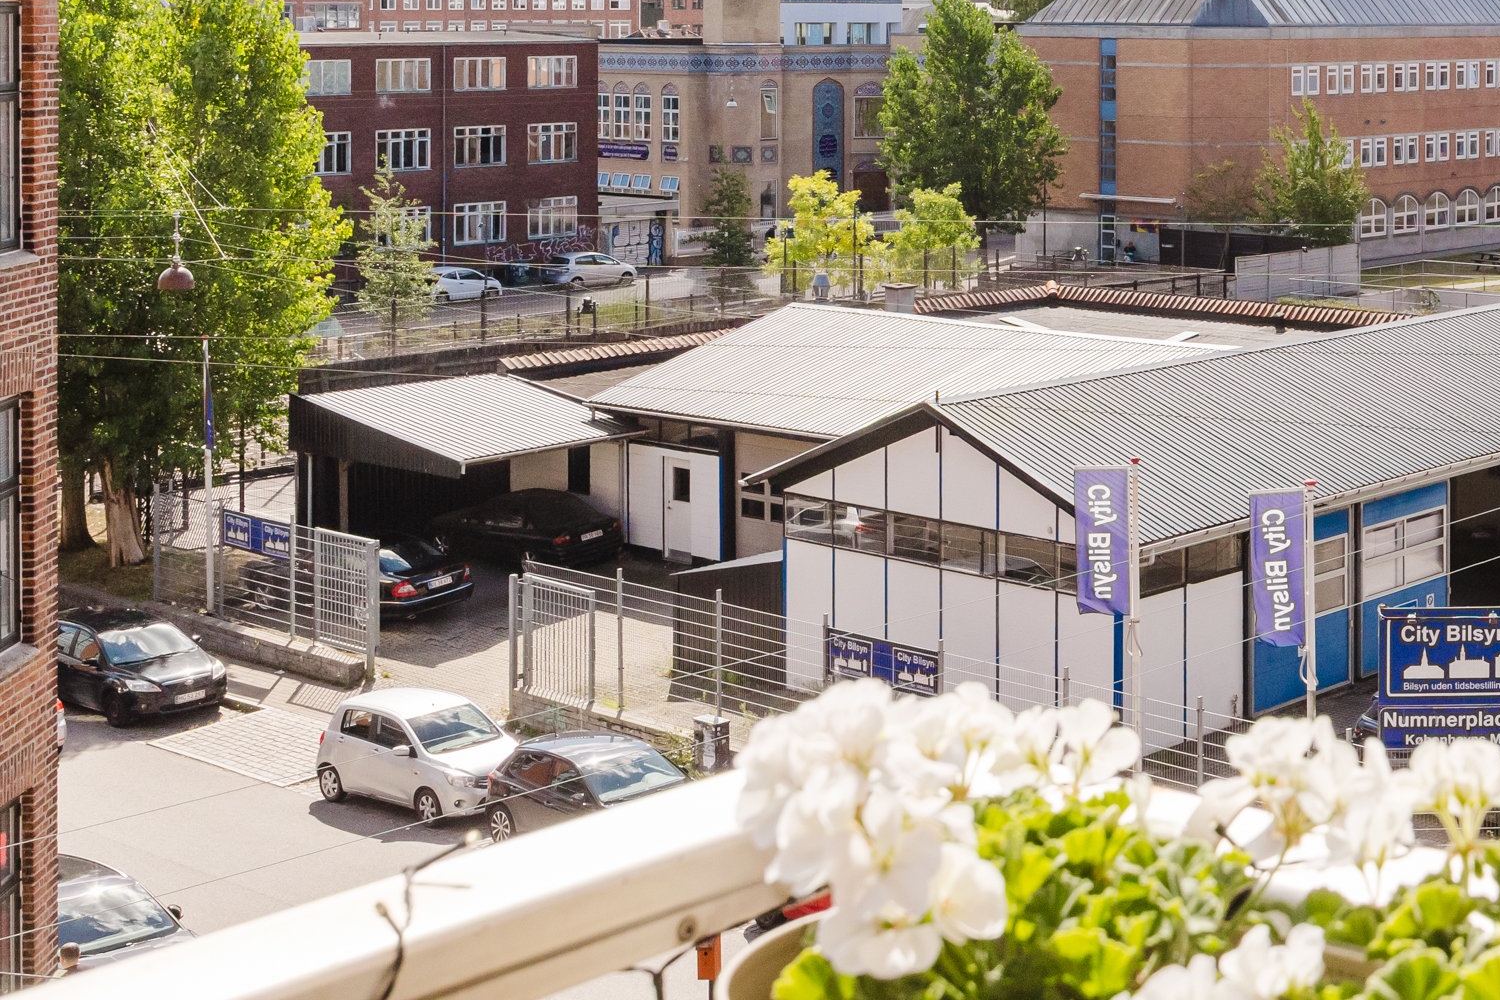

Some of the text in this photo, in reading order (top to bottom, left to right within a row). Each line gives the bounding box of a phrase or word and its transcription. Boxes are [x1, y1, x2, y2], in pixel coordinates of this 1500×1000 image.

[1400, 625, 1440, 647] City
[833, 638, 868, 654] City Bilsyn
[897, 652, 935, 669] City Bilsyn
[1403, 682, 1429, 692] Bilsyn
[1431, 682, 1453, 690] uden
